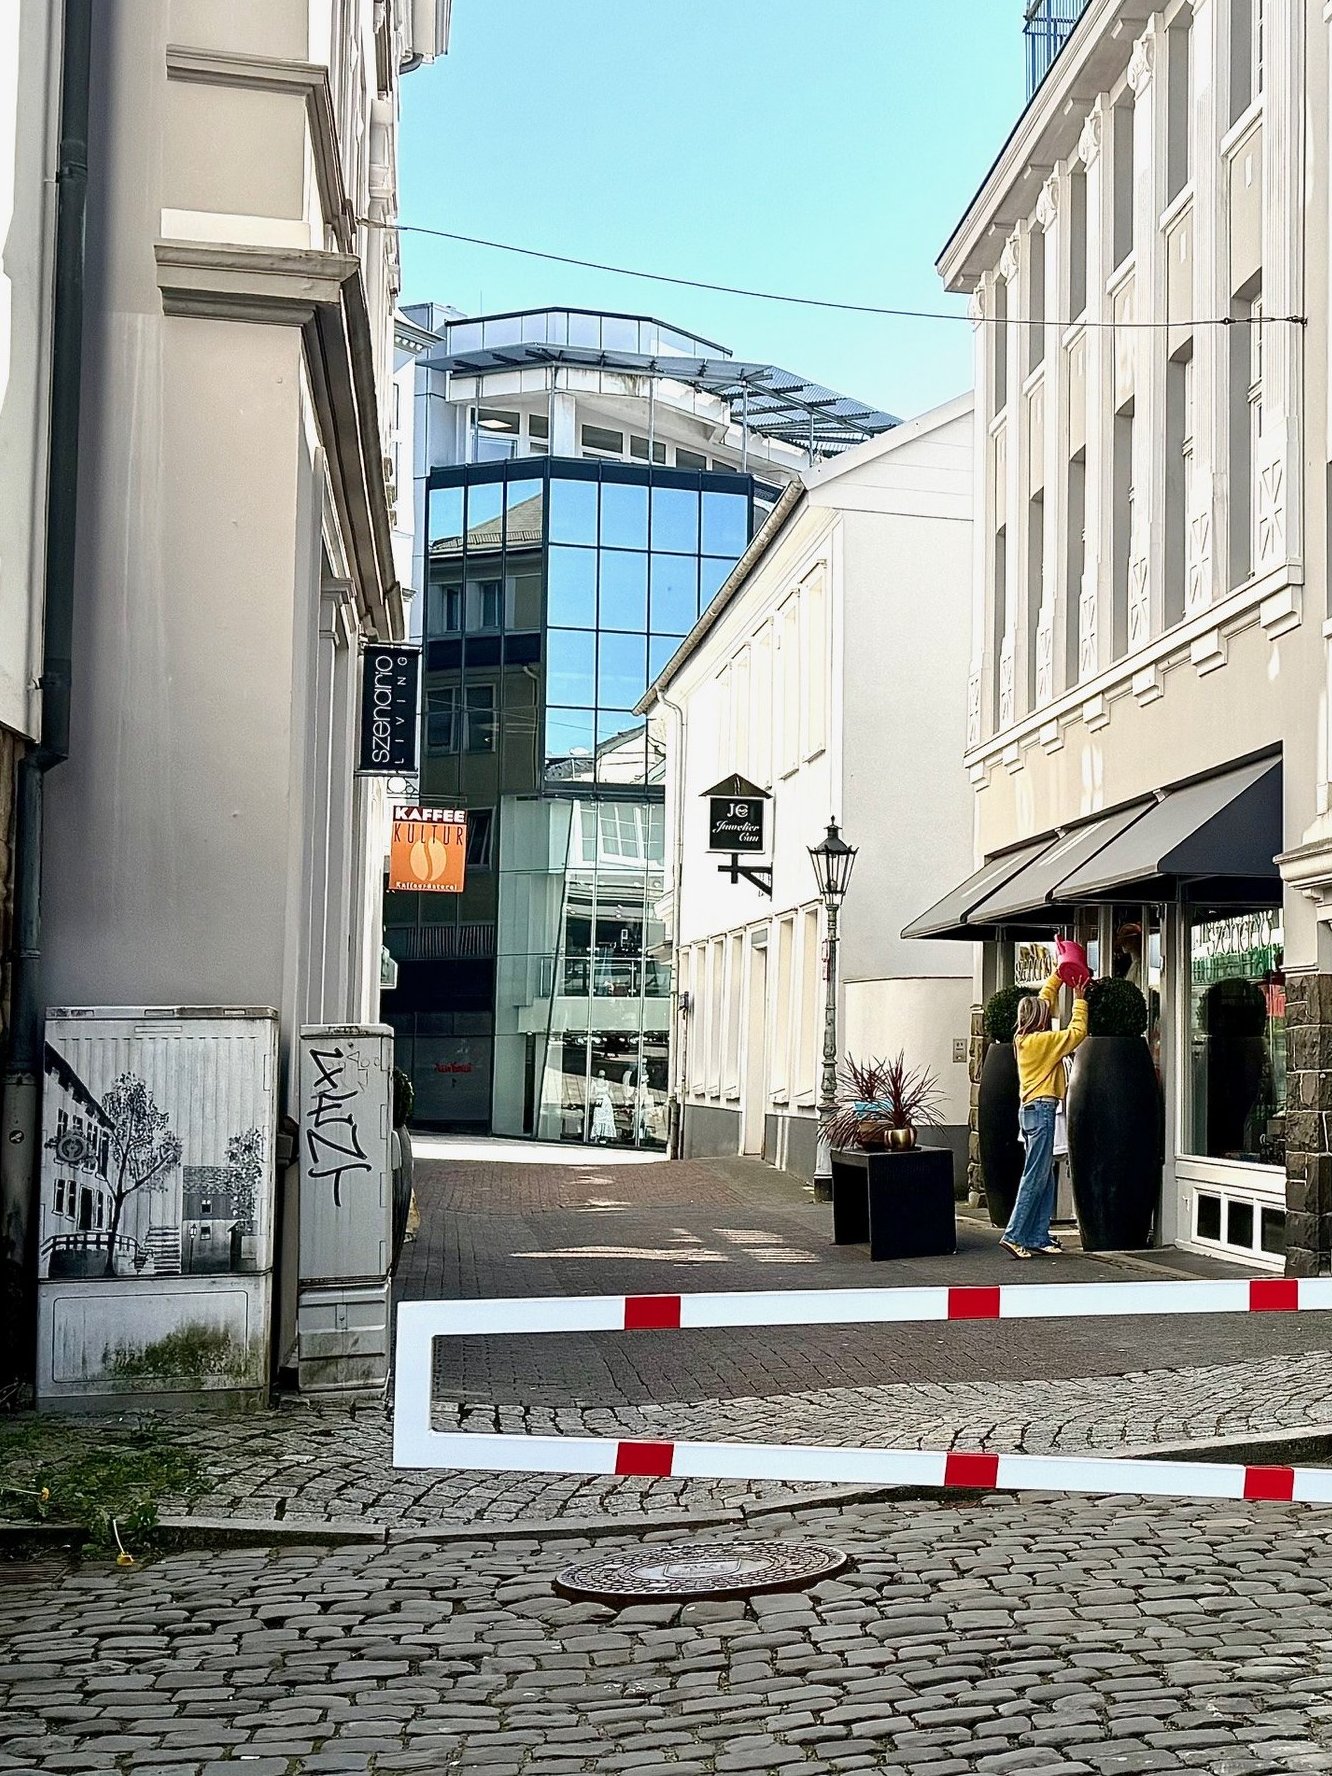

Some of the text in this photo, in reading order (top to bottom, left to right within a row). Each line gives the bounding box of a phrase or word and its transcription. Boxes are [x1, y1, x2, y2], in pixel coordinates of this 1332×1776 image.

[371, 655, 394, 764] szenario
[394, 656, 408, 764] LIVING
[394, 806, 466, 823] KAFFEE
[393, 822, 464, 846] KULTUR
[712, 820, 760, 834] Juwelier
